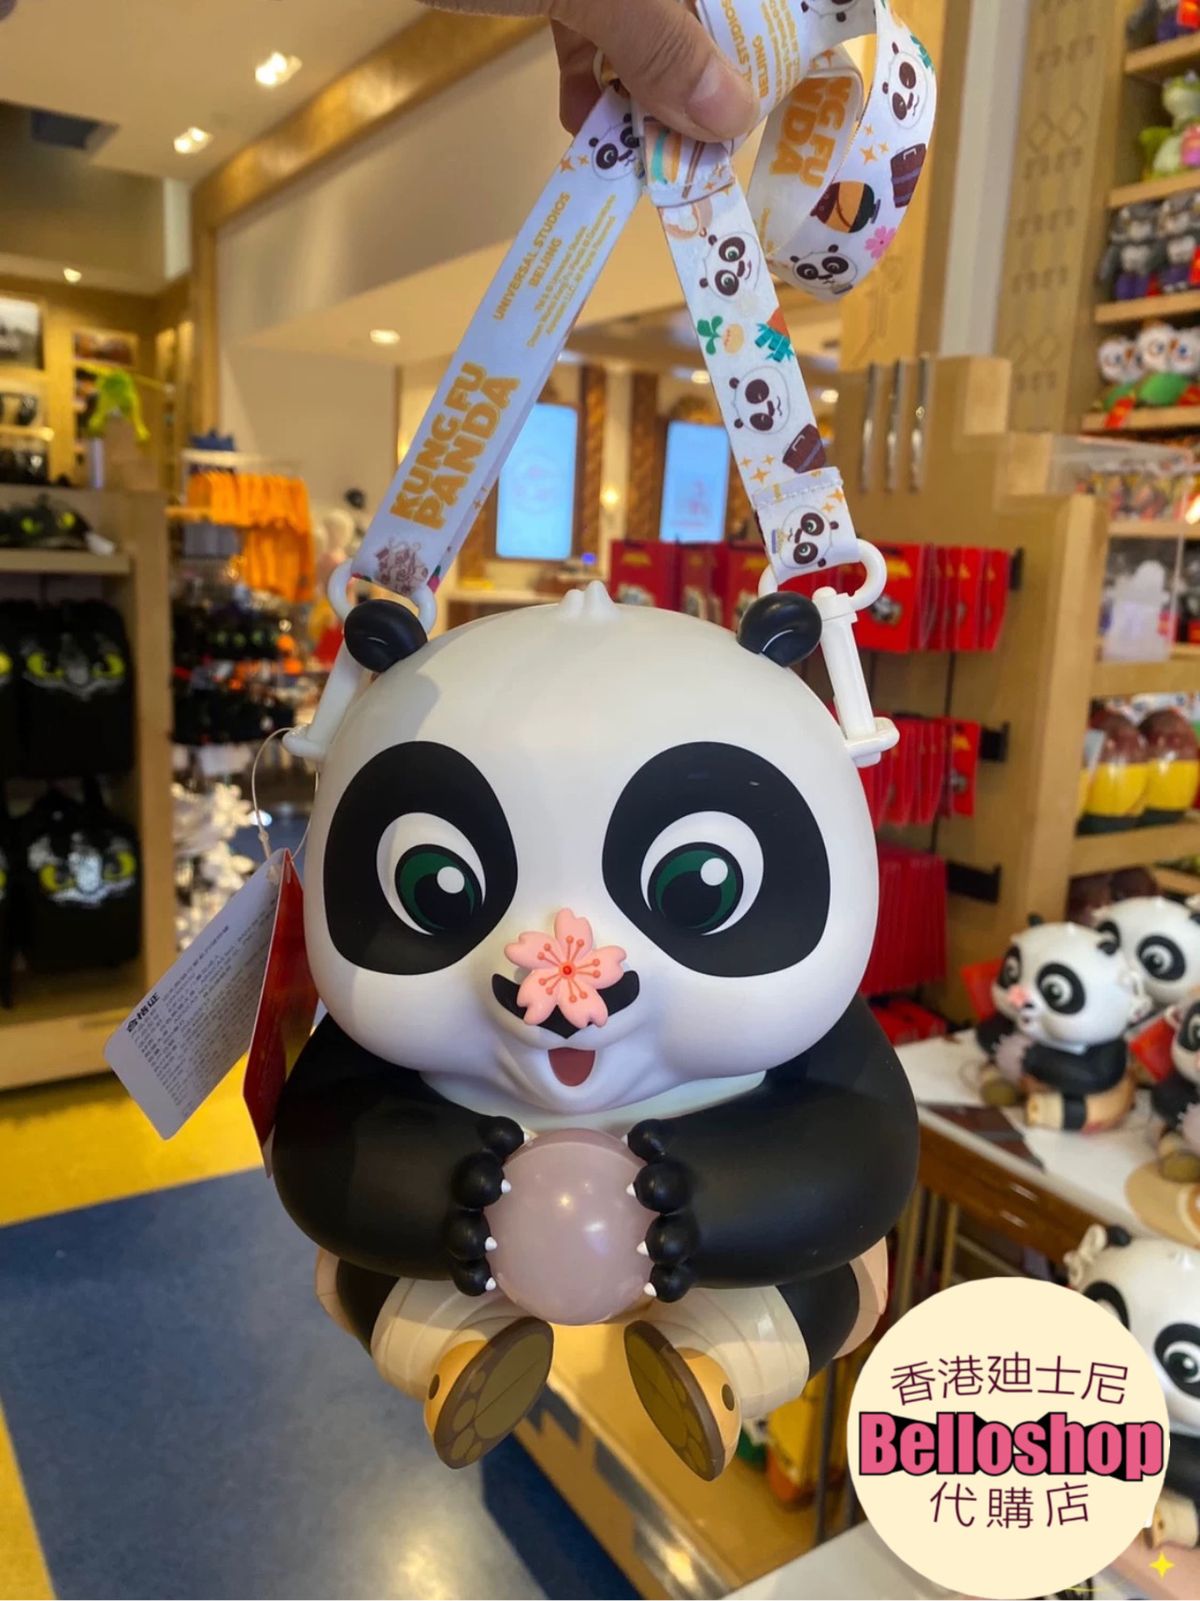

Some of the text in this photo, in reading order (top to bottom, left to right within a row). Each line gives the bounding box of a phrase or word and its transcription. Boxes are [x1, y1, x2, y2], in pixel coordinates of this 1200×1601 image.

[752, 35, 769, 98] BEIJING
[799, 134, 837, 188] FU
[493, 251, 538, 320] UNIVERSAL
[534, 192, 571, 248] STUDIOS
[529, 237, 563, 287] BEIJING
[390, 361, 488, 520] KUNG FU
[412, 377, 520, 529] PANDA
